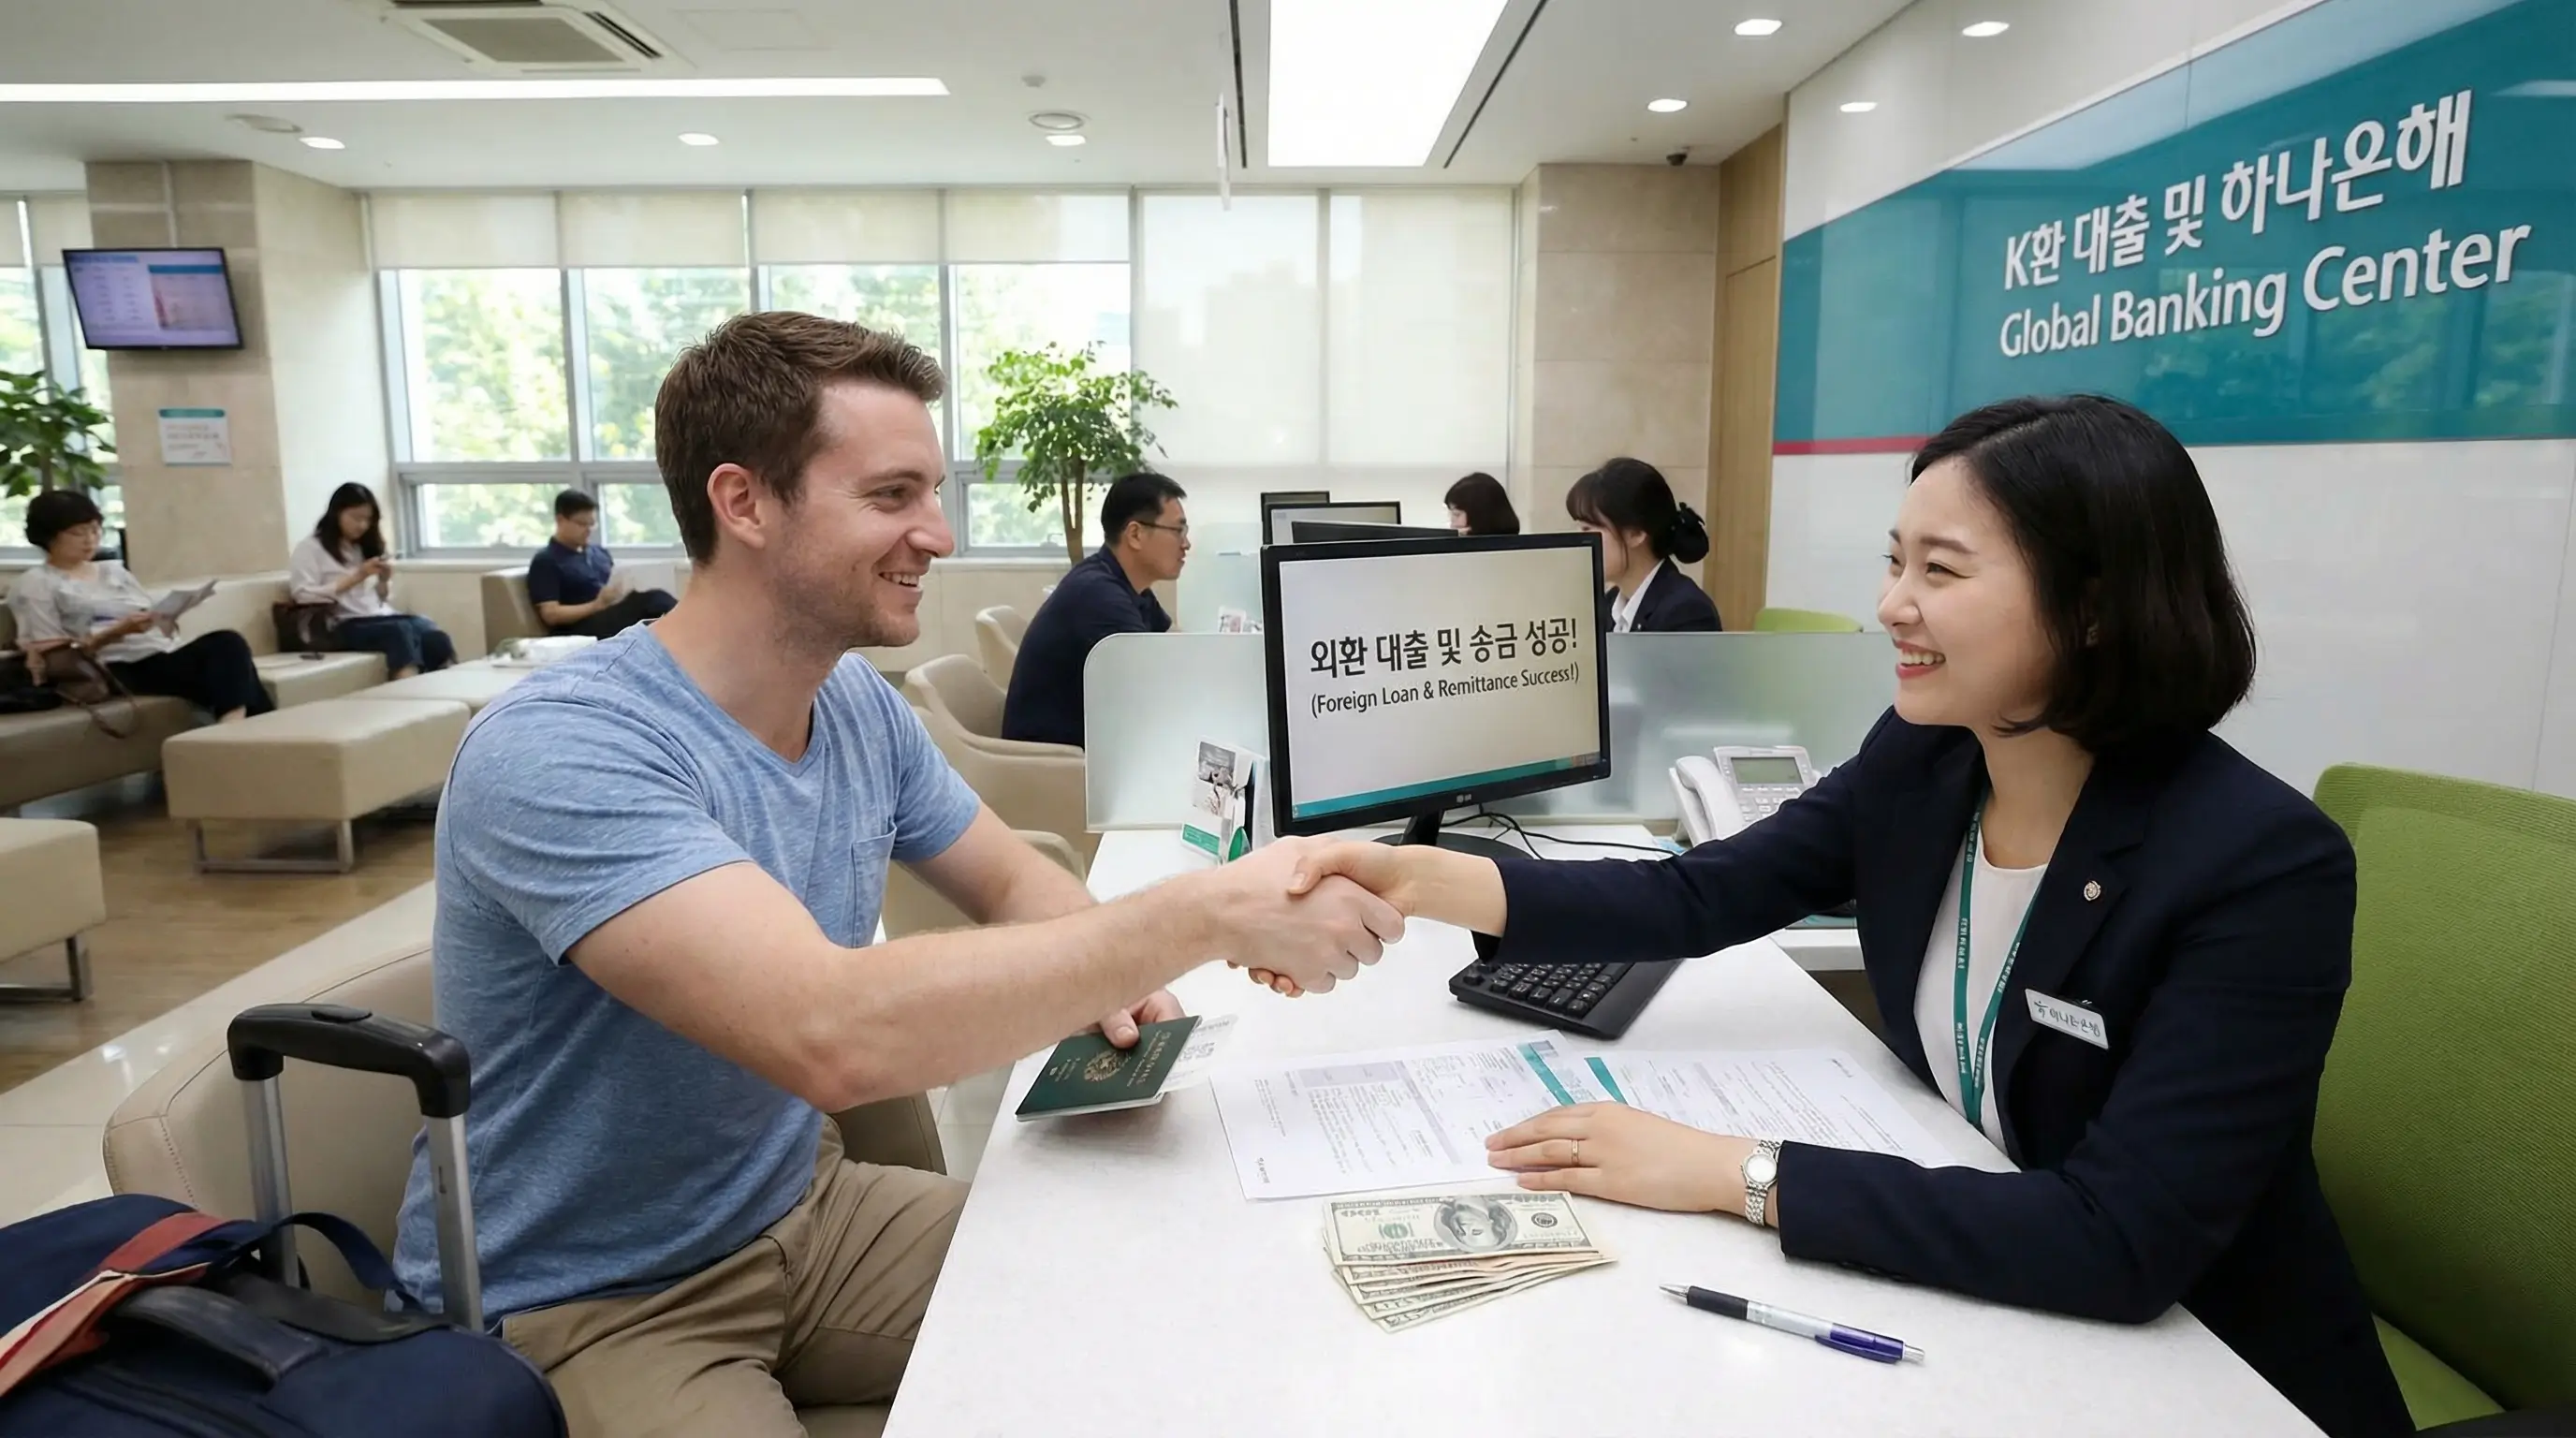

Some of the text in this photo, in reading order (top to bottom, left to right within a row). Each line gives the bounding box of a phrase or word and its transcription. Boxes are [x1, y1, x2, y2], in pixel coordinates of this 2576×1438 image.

[2004, 90, 2471, 290] K환 대출 및 하나은해
[1999, 225, 2531, 358] Global Banking Center
[1310, 618, 1577, 679] 외환 대출 및 송금 성공!
[1311, 661, 1579, 719] (Foreign Loan & Remittance Success!)
